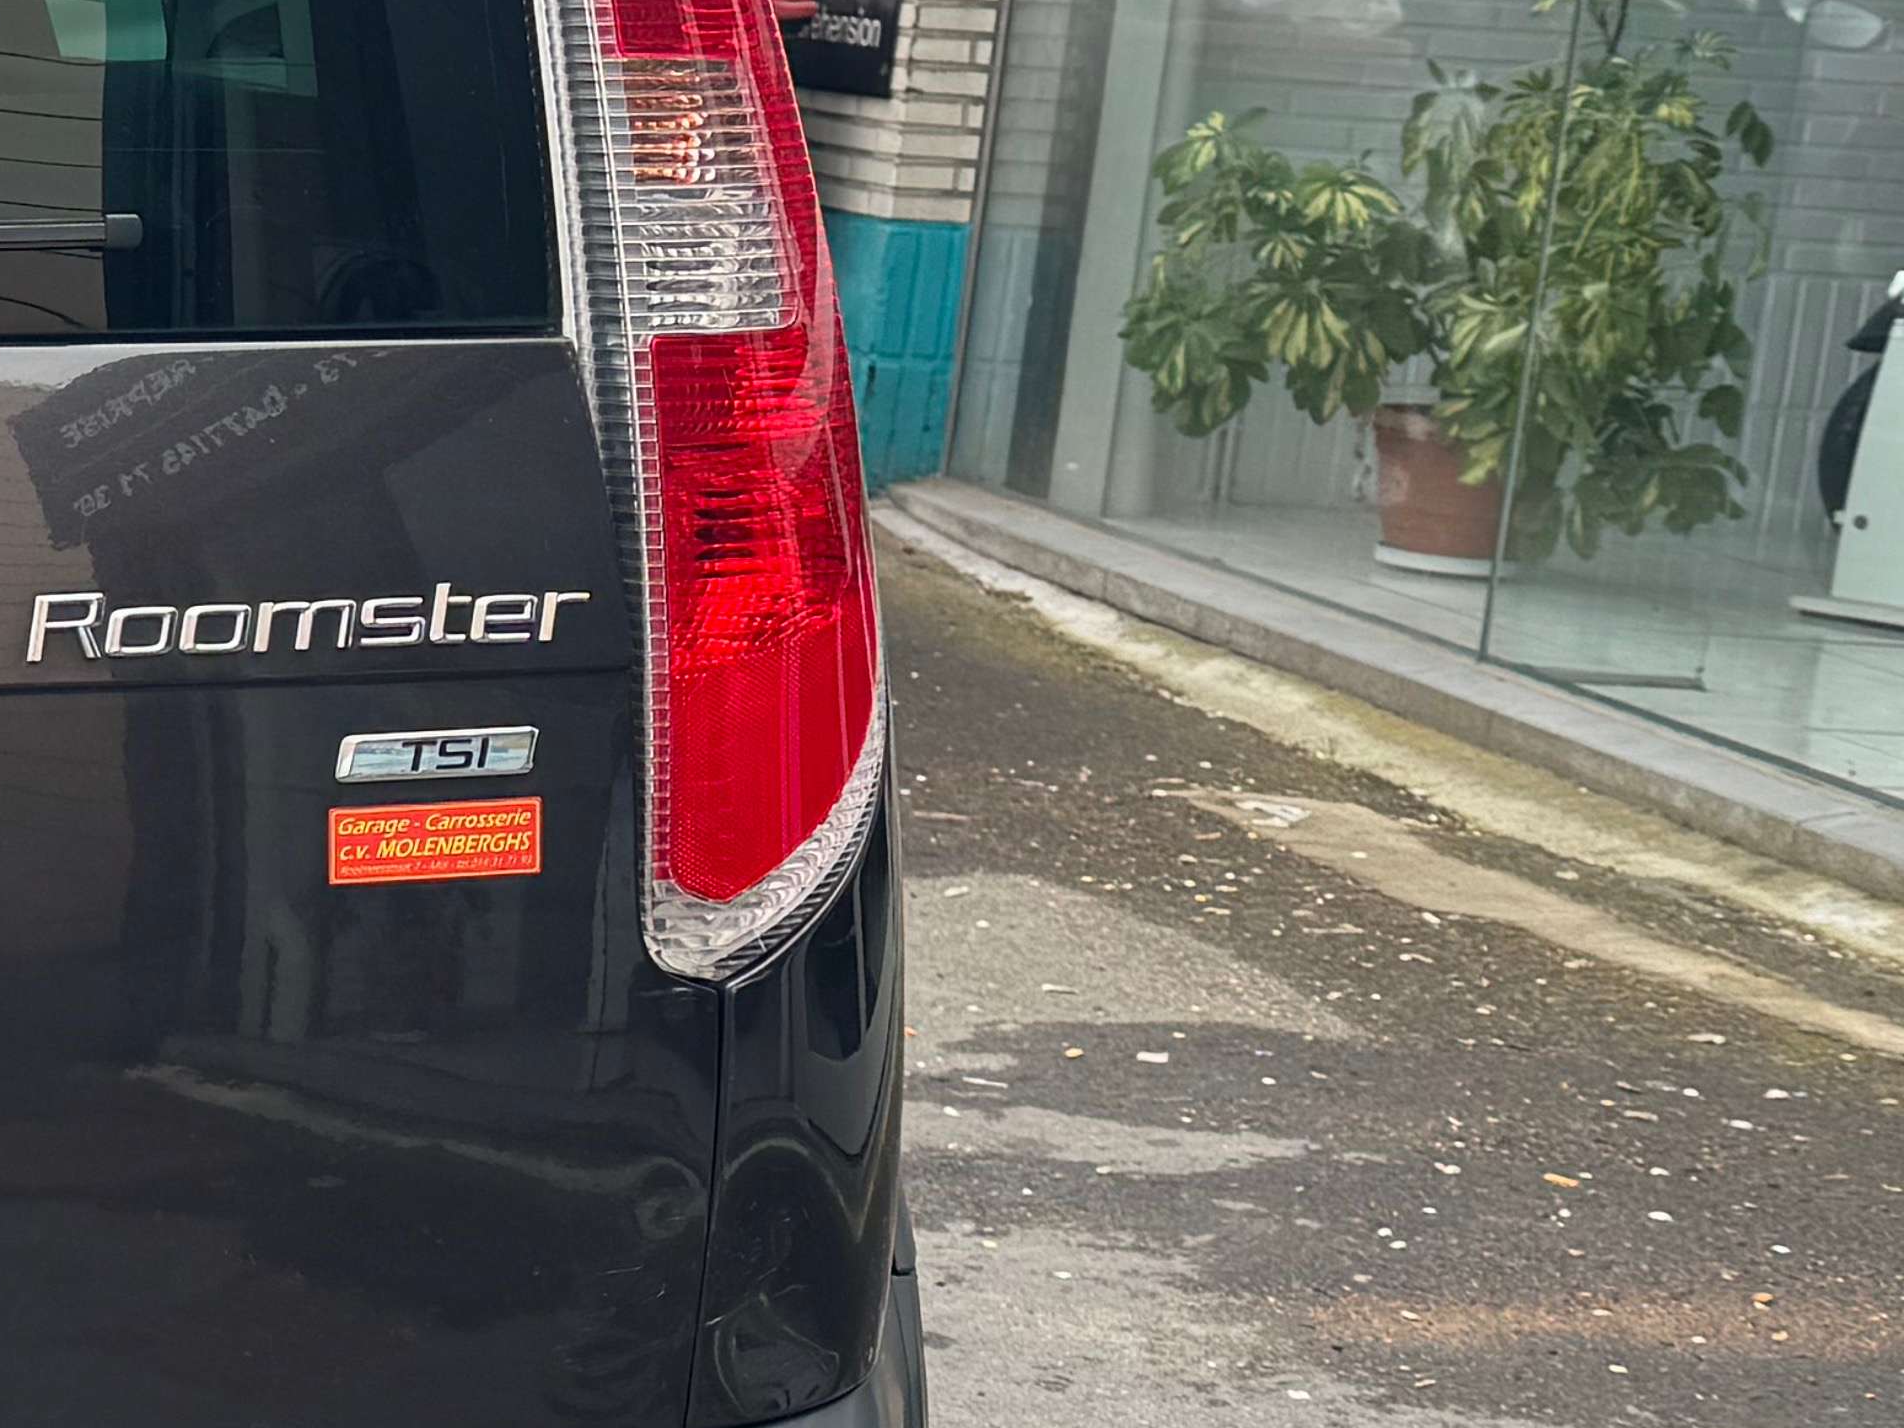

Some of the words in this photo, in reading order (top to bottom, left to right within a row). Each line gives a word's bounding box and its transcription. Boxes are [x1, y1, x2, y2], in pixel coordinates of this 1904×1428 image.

[26, 582, 590, 662] Roomster
[402, 737, 490, 771] TSI
[338, 817, 410, 837] Garage
[425, 808, 532, 832] Carrosserie
[376, 831, 532, 859] MOLENBERGHS
